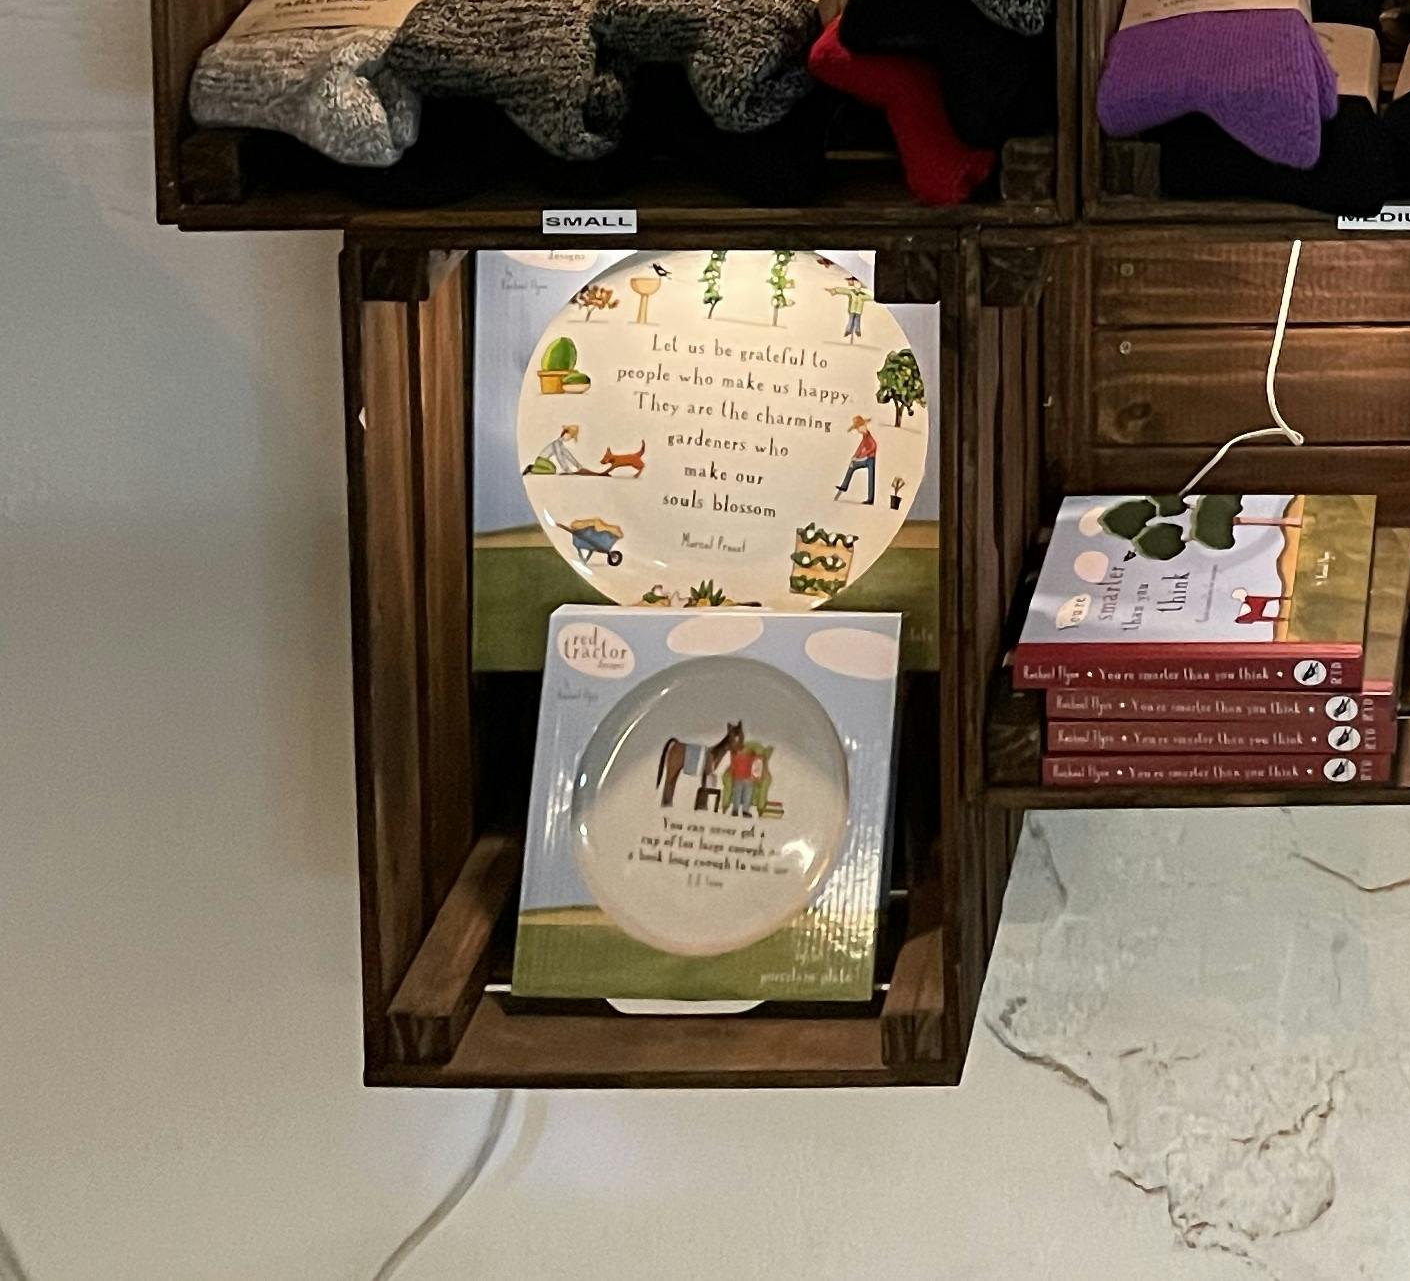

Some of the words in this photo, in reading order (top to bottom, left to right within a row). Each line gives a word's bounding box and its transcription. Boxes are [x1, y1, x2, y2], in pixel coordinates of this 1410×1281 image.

[546, 216, 632, 227] SMALL
[652, 334, 678, 353] Let
[688, 342, 705, 355] us
[715, 339, 733, 358] be
[740, 344, 805, 366] grateful
[812, 354, 828, 369] to
[616, 364, 670, 383] people
[679, 370, 714, 388] who
[722, 373, 764, 392] make
[773, 382, 789, 395] us
[633, 390, 679, 417] They
[687, 403, 713, 416] are
[721, 399, 748, 421] the
[757, 409, 832, 433] charming
[667, 429, 746, 452] gardeners
[755, 440, 789, 458] who
[684, 461, 728, 482] make
[736, 473, 764, 486] our
[663, 493, 703, 510] souls
[713, 493, 776, 518] blossom
[564, 638, 629, 661] tractor
[572, 627, 597, 647] red
[1239, 667, 1268, 681] think
